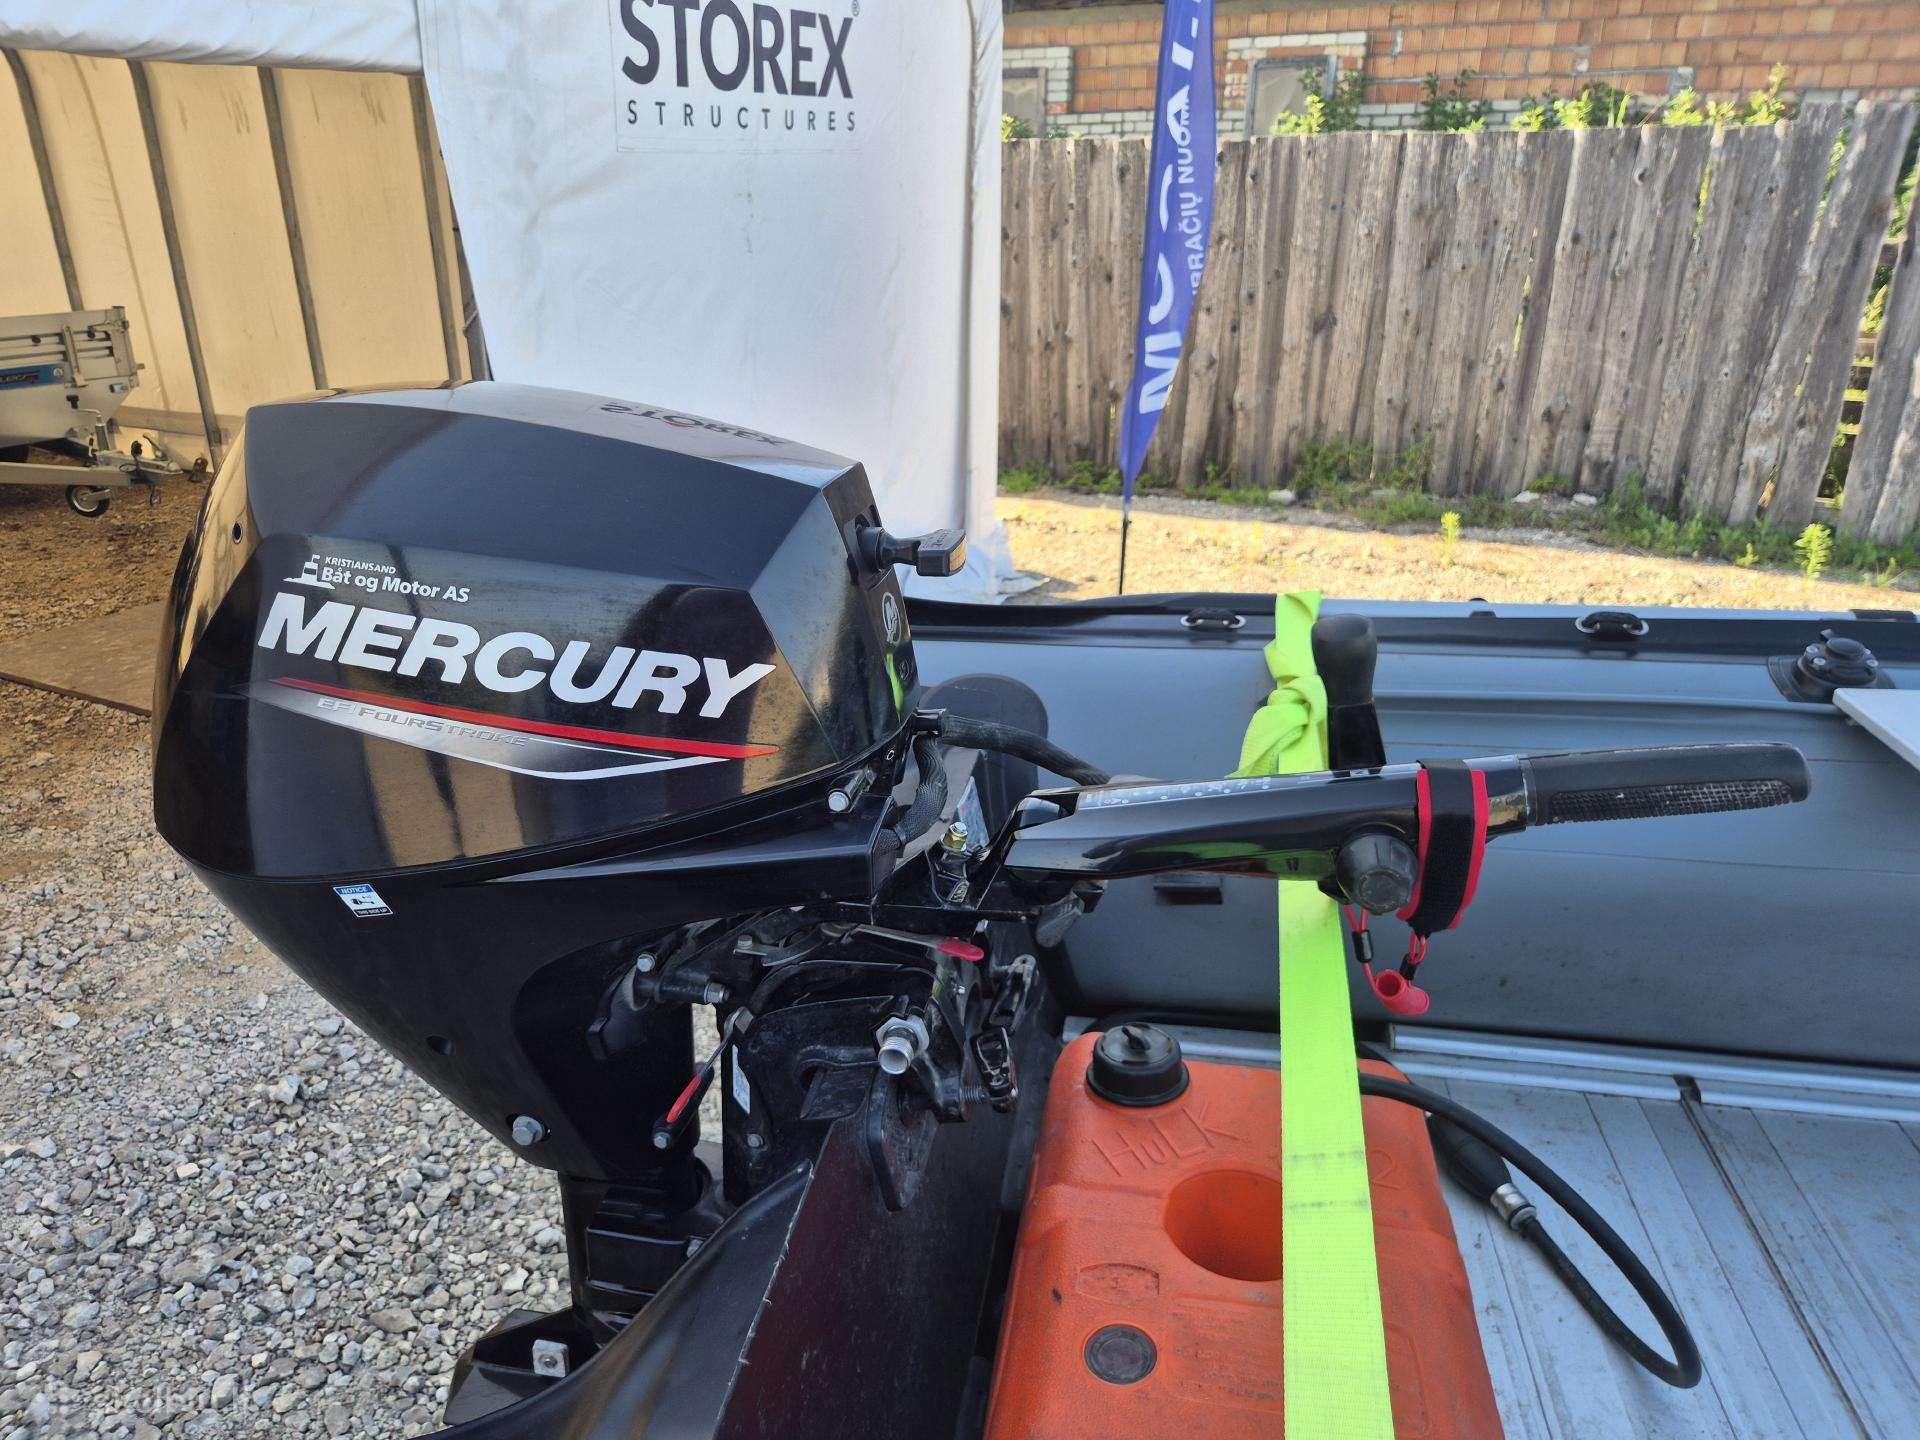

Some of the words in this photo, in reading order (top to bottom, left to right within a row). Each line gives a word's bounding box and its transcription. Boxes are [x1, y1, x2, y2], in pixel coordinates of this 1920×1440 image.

[620, 0, 854, 98] STOREX
[628, 99, 856, 131] STRUCTURES
[321, 566, 352, 585] Båt
[354, 574, 379, 593] og
[382, 576, 441, 598] Motor
[442, 585, 472, 603] AS
[324, 556, 397, 575] KRISTIANSAND
[257, 591, 777, 719] MERCURY
[358, 706, 530, 748] FOURSTROKE
